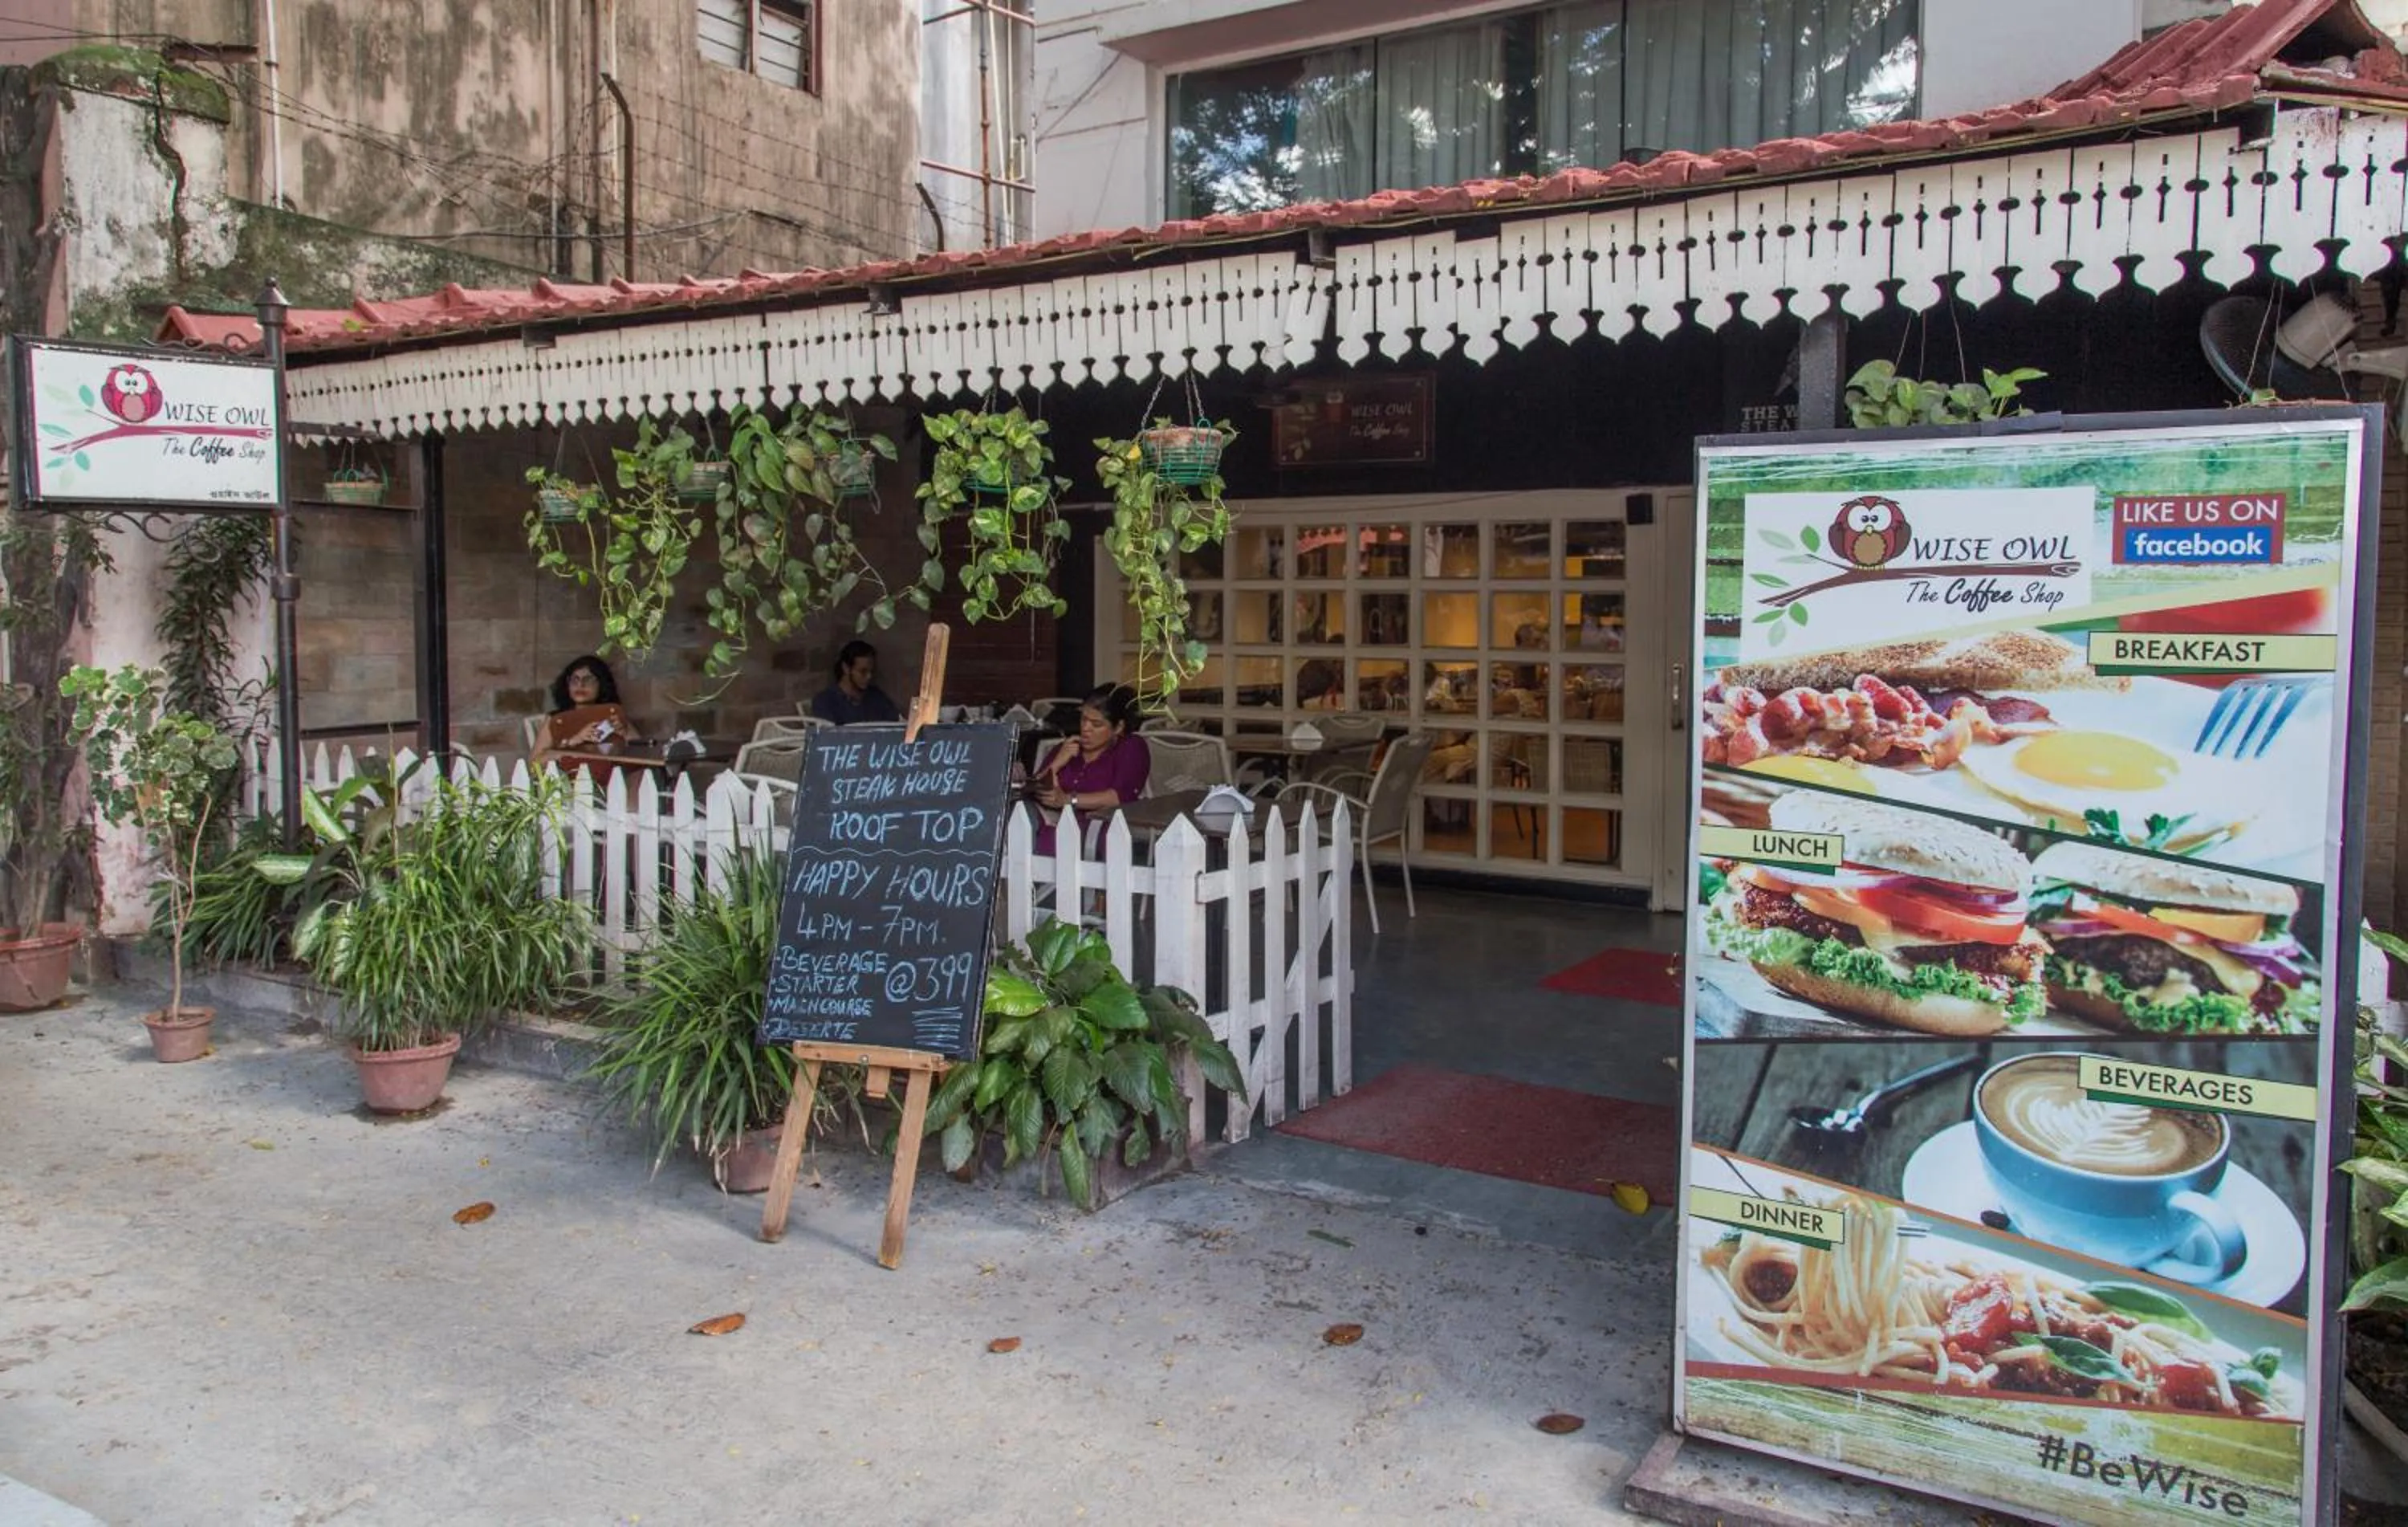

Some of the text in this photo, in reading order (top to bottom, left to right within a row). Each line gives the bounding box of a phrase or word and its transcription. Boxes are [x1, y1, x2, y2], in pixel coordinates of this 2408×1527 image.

[165, 401, 270, 426] WISE OWL
[1742, 405, 1780, 420] THE
[162, 437, 266, 465] The Coffee Shop
[2122, 499, 2278, 523] LIKE US ON
[1913, 535, 2076, 561] WISE OWL
[2134, 531, 2264, 556] facebook
[1906, 578, 2064, 613] The Coffee Shop
[2115, 639, 2265, 663] BREAKFAST
[818, 740, 972, 772] THE WISE OWL
[832, 768, 969, 804] STEAK HOUSE
[829, 807, 984, 844] ROOF TOP
[1753, 835, 1828, 858] LUNCH
[792, 860, 990, 908] HAPPY HOURS
[780, 945, 889, 974] BEVERAGE
[775, 974, 860, 995] STARTER
[2099, 1065, 2254, 1105] BEVERAGES
[1741, 1201, 1824, 1234] DINNER
[2037, 1434, 2249, 1517] #BeWise
